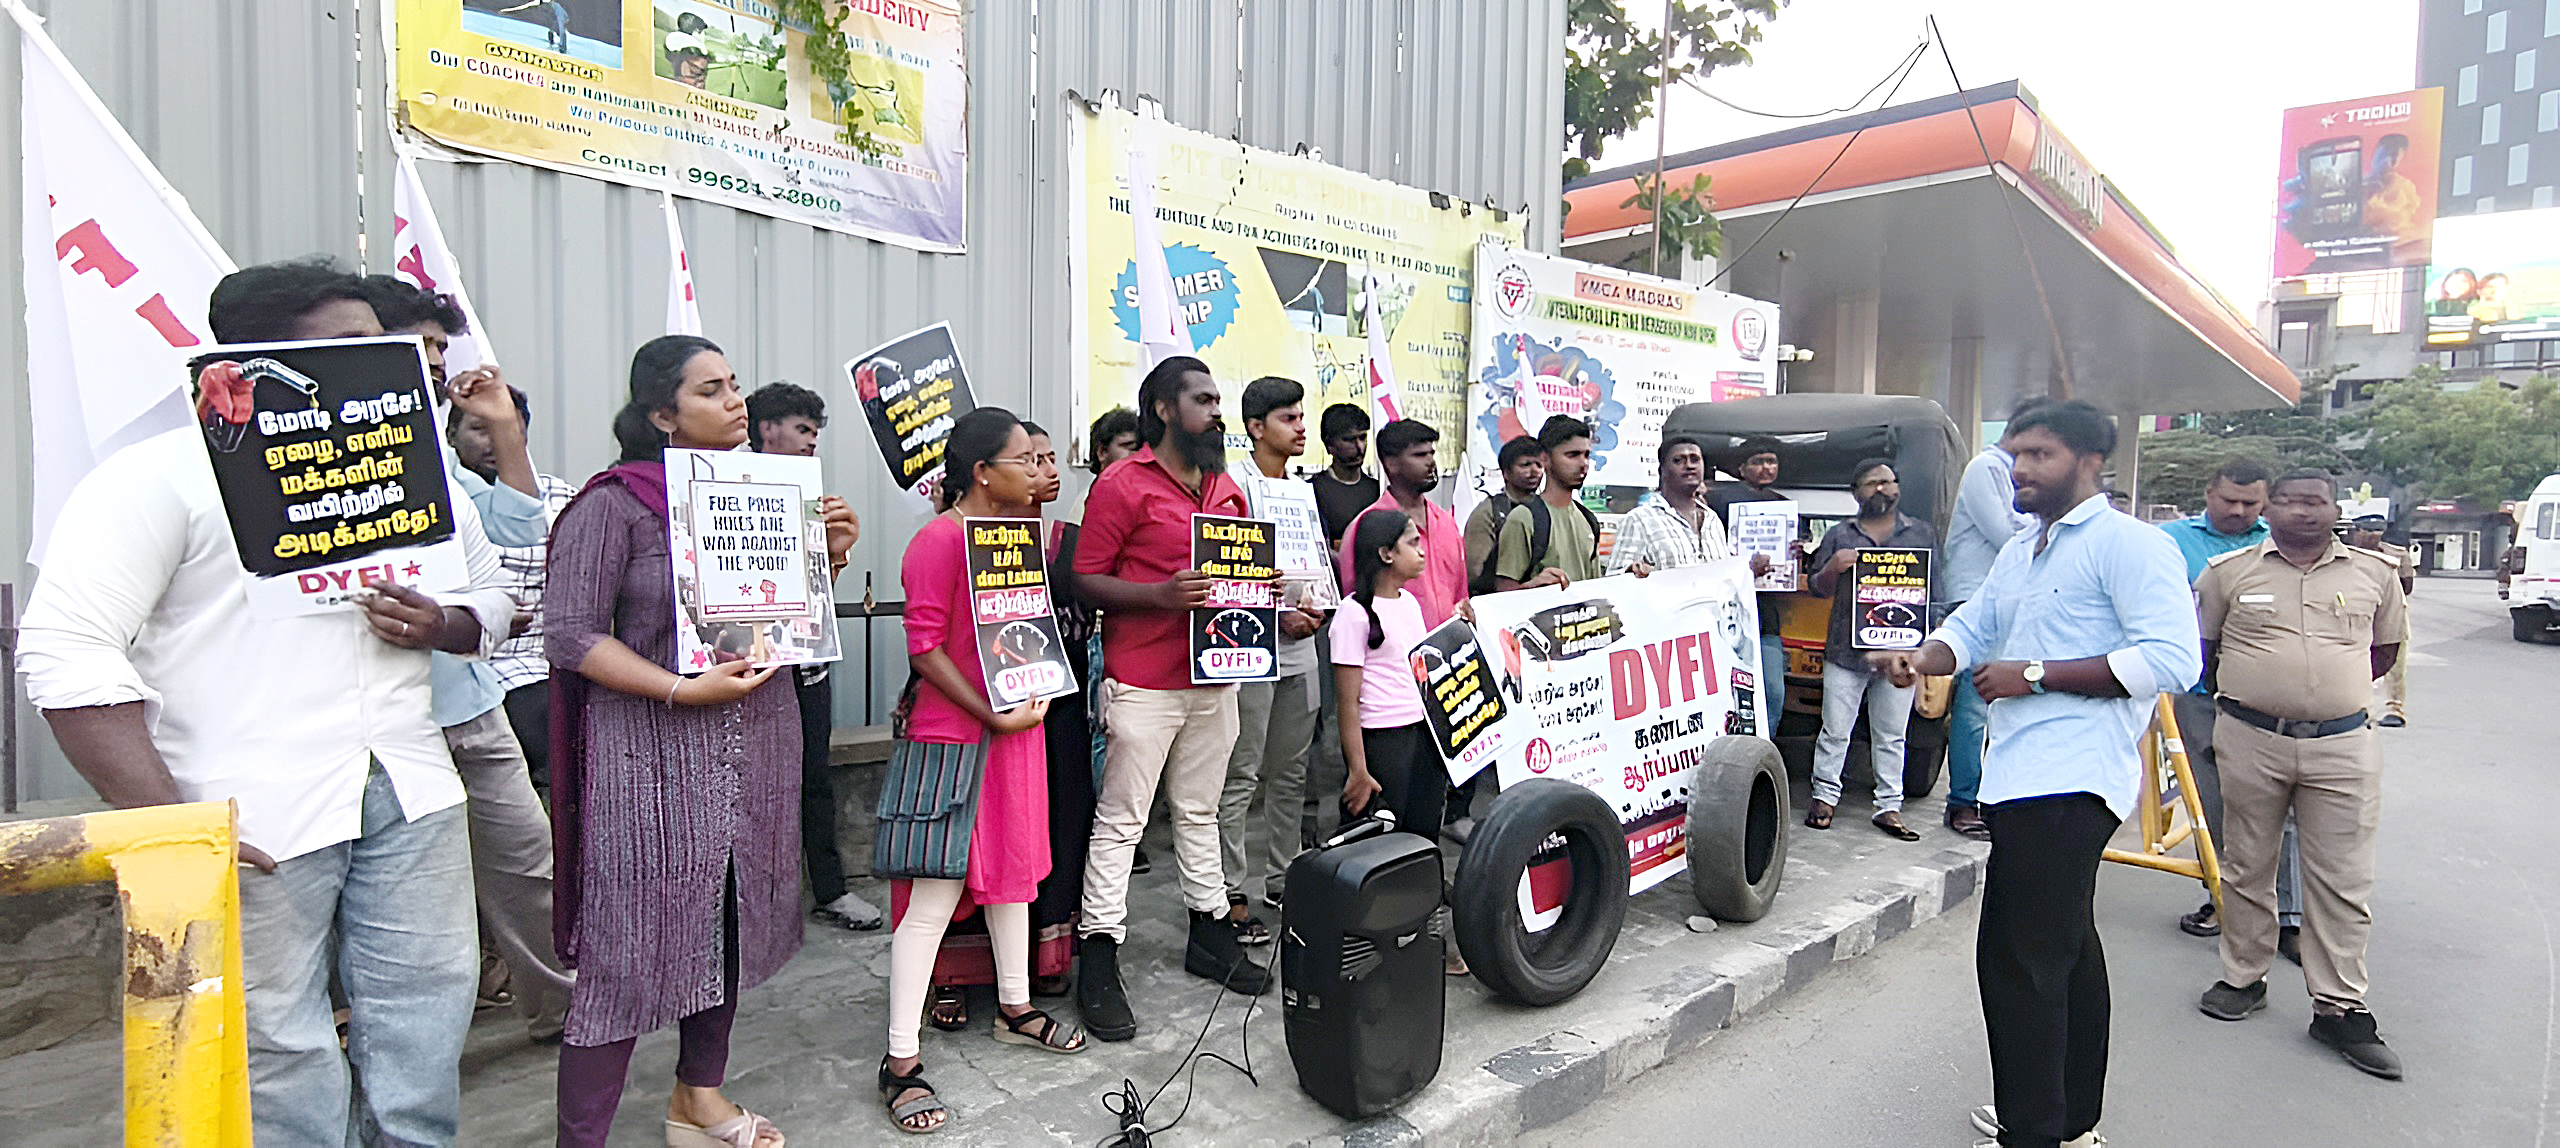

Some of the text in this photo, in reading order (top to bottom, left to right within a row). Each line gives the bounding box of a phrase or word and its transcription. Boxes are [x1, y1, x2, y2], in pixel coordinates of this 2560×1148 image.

[582, 149, 667, 177] Contact
[1124, 269, 1225, 308] SMER
[1581, 278, 1683, 311] YMCA MADRAS
[258, 389, 423, 436] மோடி அரசே!
[347, 423, 413, 453] எளிய
[281, 451, 404, 495] மக்களின்
[287, 481, 404, 522] வயிற்றில்
[709, 496, 742, 512] FUEL
[274, 503, 438, 558] அடிக்காதே!
[714, 516, 784, 532] HIKES ARE
[703, 536, 797, 552] WAR AGAINST
[717, 556, 743, 571] THE
[1211, 652, 1251, 668] DYFI
[1005, 667, 1045, 691] DYFI
[1609, 631, 1719, 721] DYFI
